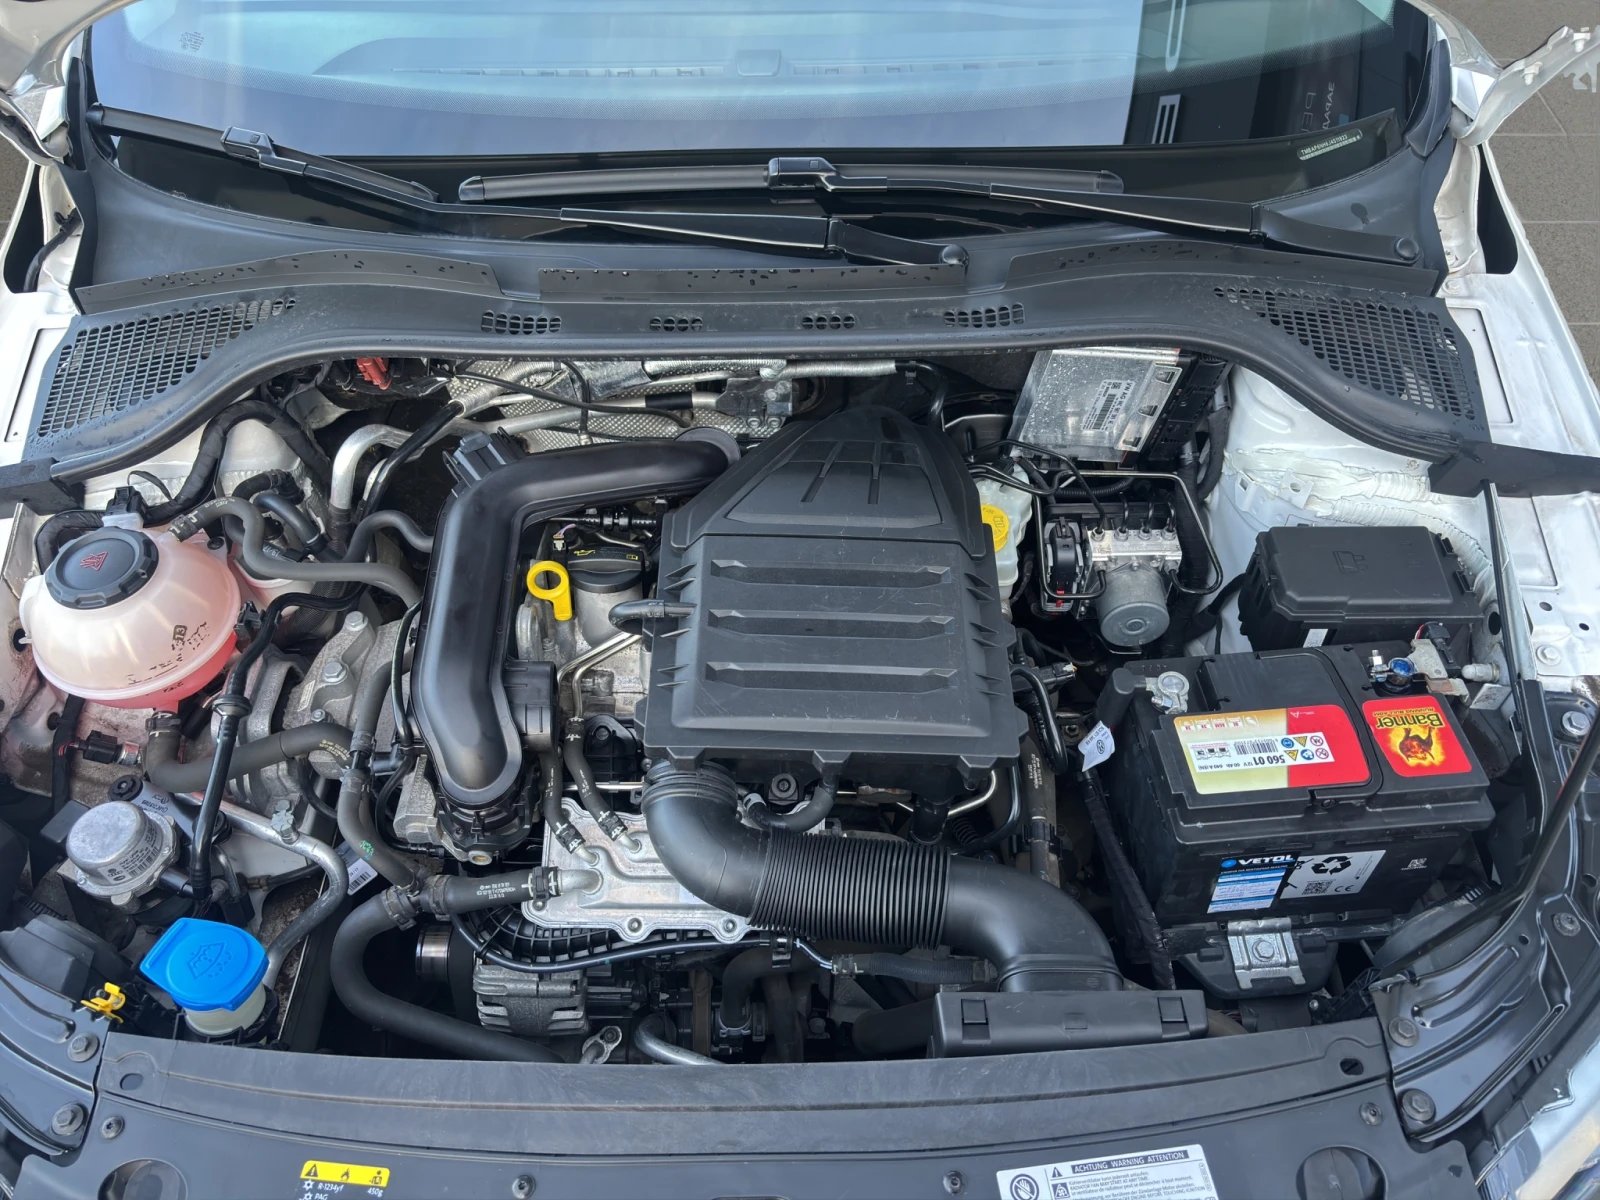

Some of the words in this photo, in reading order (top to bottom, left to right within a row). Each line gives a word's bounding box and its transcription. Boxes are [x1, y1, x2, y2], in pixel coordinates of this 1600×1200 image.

[1376, 712, 1444, 728] Banner
[1253, 756, 1265, 766] 01
[1266, 754, 1286, 764] 560
[1074, 1162, 1108, 1172] ACHTUNG
[1111, 1156, 1144, 1168] WARNING
[1148, 1152, 1184, 1163] ATTENTION
[317, 1182, 344, 1193] R-1234yf
[367, 1187, 383, 1198] 450g
